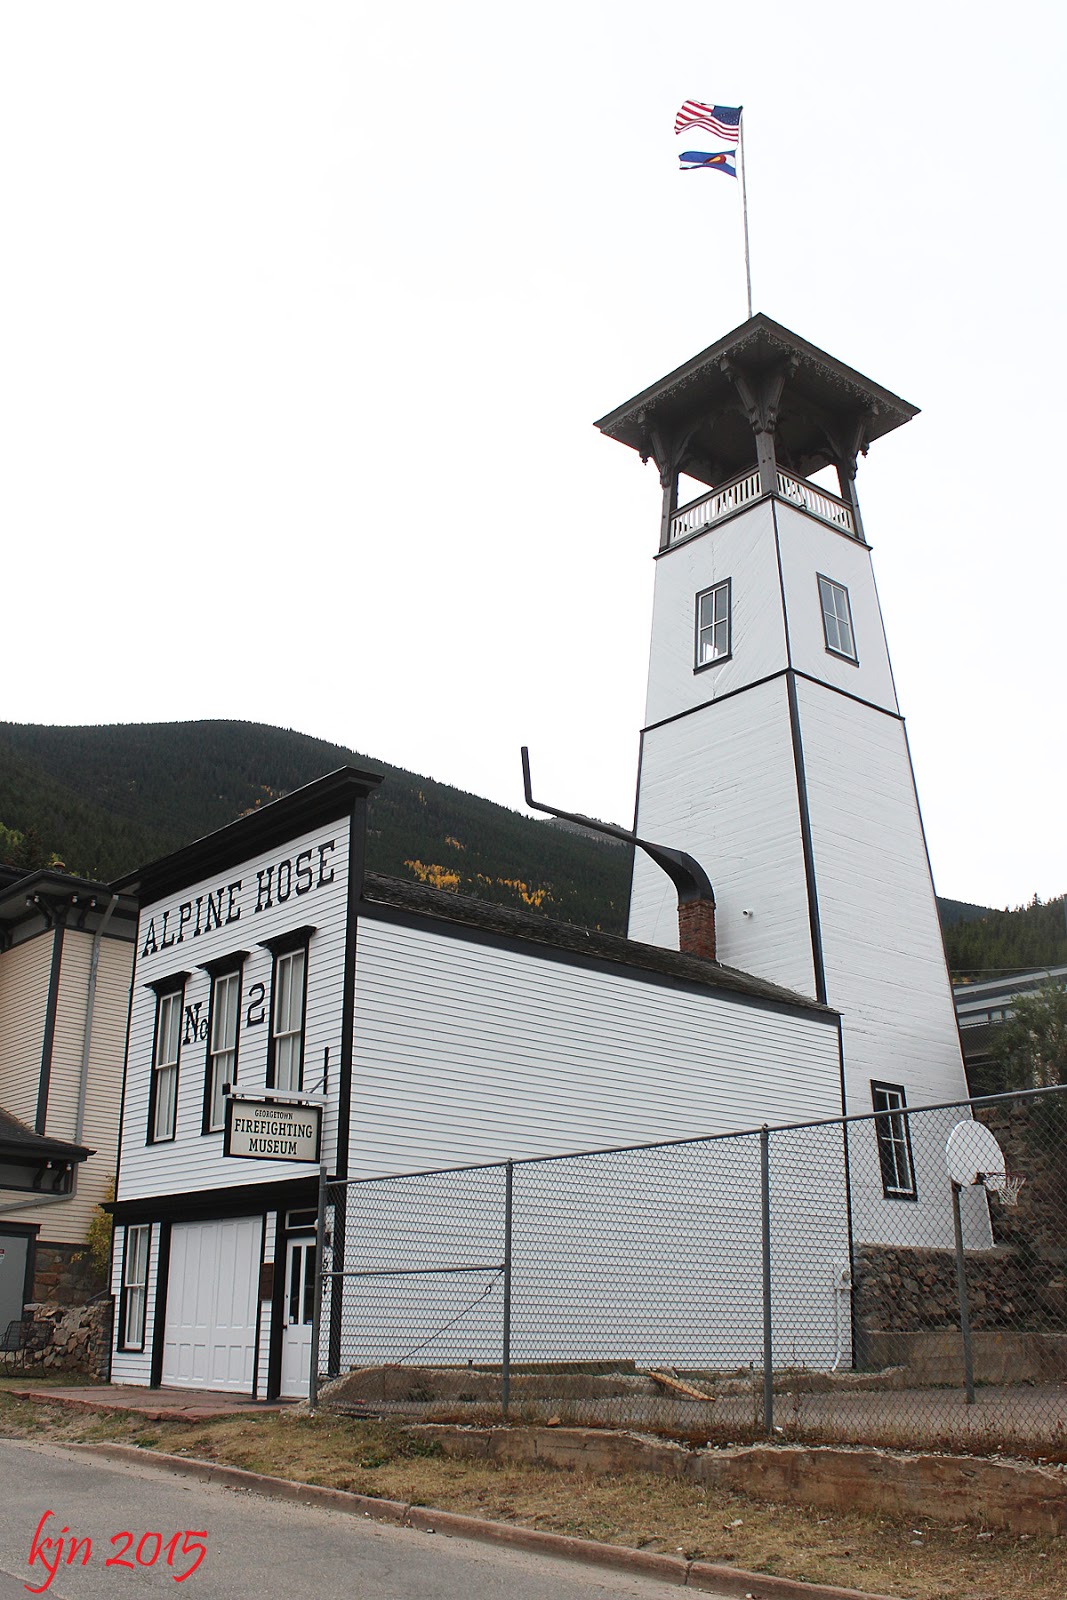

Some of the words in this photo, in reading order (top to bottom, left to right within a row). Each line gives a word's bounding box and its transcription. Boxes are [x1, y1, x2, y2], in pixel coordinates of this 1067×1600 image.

[142, 880, 242, 958] ALPINE
[254, 840, 336, 914] HOSE
[246, 983, 266, 1028] 2
[254, 1109, 294, 1120] GEORGETOWN
[234, 1118, 313, 1138] FIREFIGHTING
[248, 1138, 298, 1155] MUSEUM
